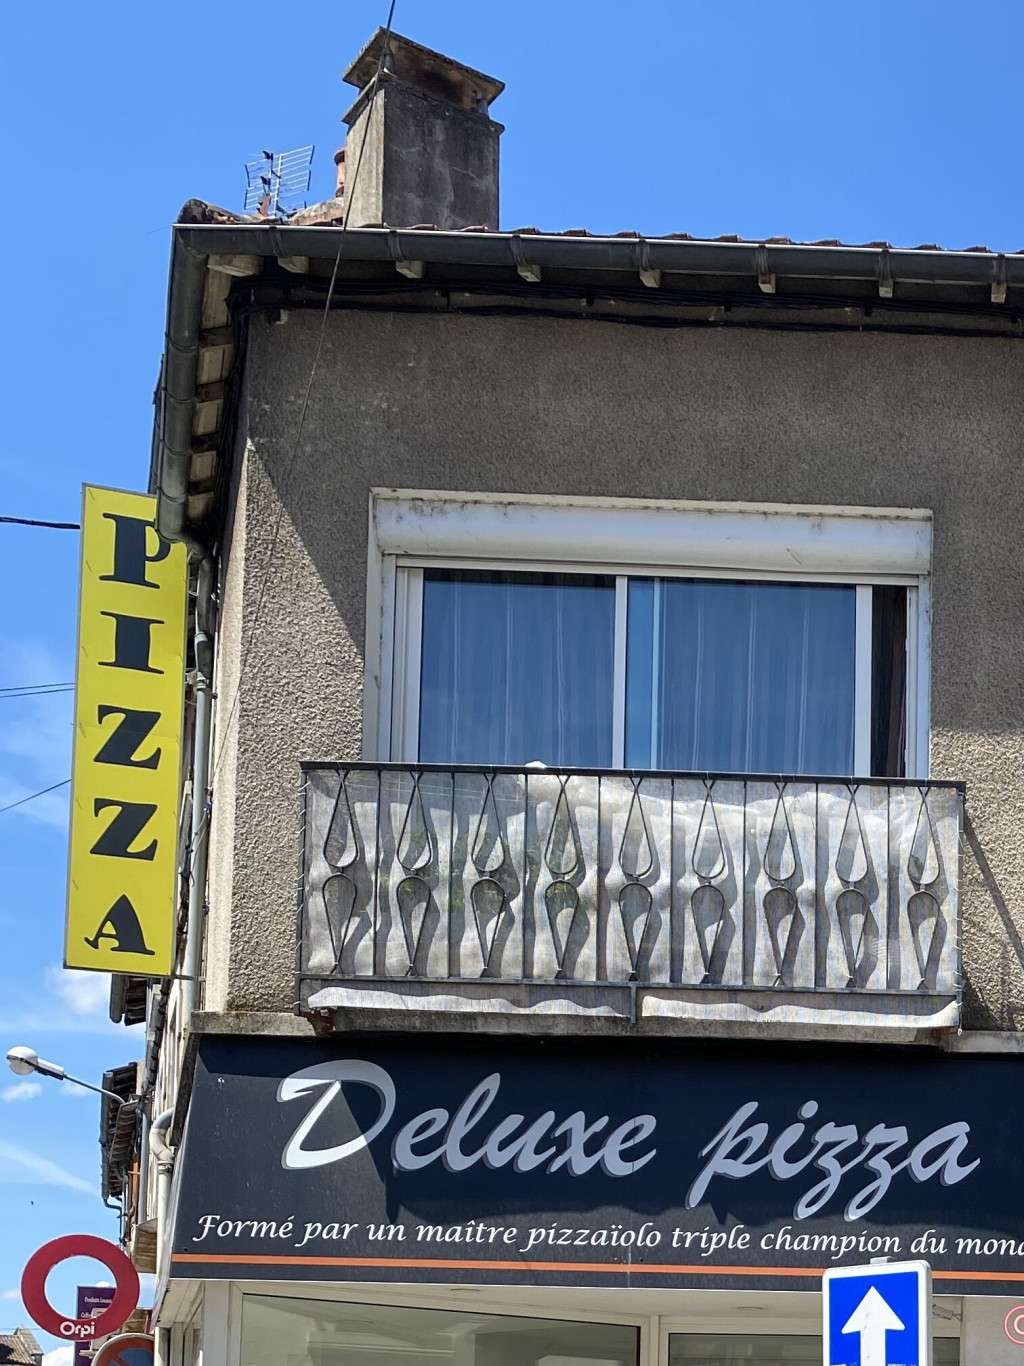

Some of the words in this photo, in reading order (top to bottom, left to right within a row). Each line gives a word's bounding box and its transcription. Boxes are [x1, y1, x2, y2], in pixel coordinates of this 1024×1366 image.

[84, 512, 171, 957] PIZZA
[276, 1059, 657, 1177] Deluxe
[685, 1100, 981, 1222] pizza
[192, 1214, 296, 1243] Formé
[295, 1221, 359, 1247] par
[367, 1223, 406, 1242] un
[415, 1219, 518, 1245] maître
[518, 1221, 661, 1253] pizzaïolo
[671, 1224, 751, 1256] triple
[760, 1226, 902, 1259] champion
[910, 1229, 948, 1255] du
[59, 1320, 96, 1338] Orpi
